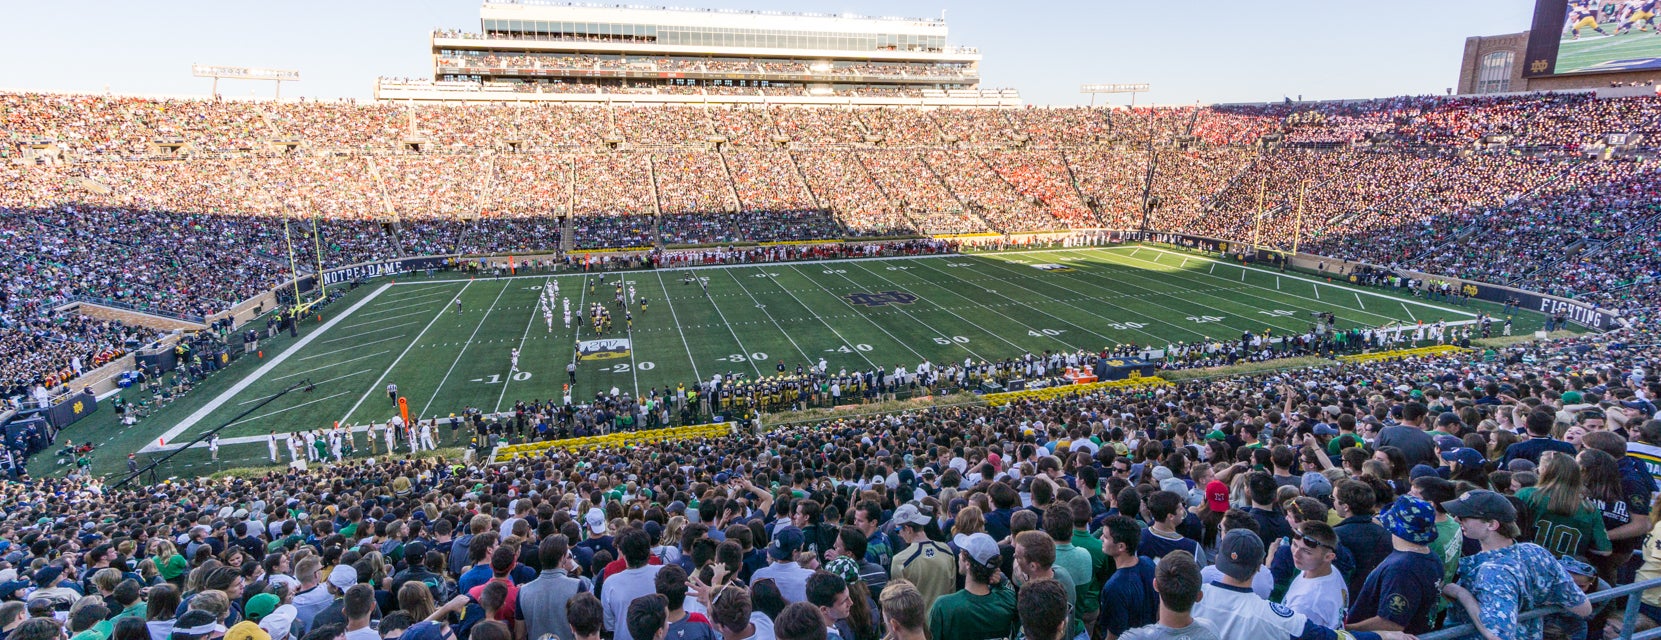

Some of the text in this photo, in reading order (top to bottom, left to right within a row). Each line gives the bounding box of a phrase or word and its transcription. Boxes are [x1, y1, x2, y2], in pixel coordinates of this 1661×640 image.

[1531, 59, 1548, 72] ND
[1028, 328, 1060, 338] 40
[932, 335, 970, 345] 50
[835, 343, 874, 354] 40
[728, 352, 769, 363] 30
[612, 361, 656, 373] 20
[484, 371, 533, 385] 10
[1533, 520, 1582, 556] 10
